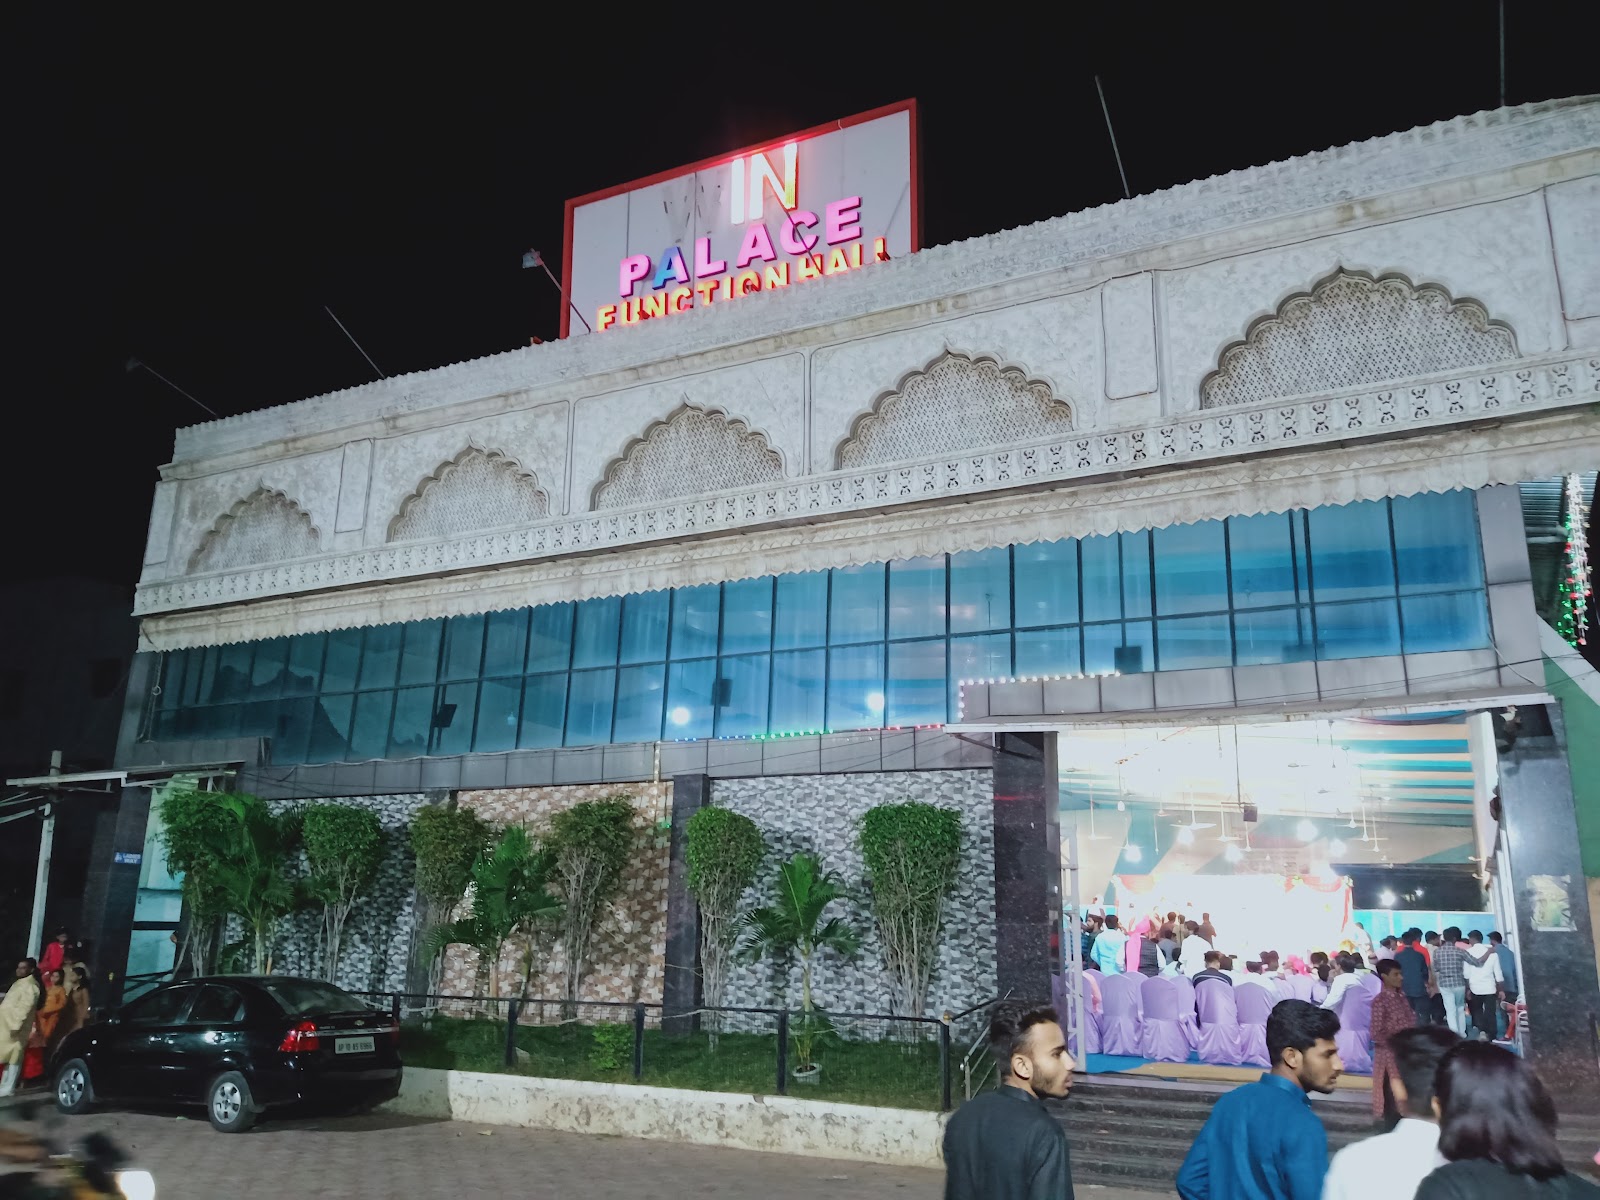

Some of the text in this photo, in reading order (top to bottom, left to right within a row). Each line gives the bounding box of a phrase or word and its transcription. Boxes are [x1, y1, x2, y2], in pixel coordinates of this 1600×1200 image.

[731, 142, 799, 225] IN
[619, 195, 863, 298] PALACE
[596, 262, 790, 333] FUNCTION
